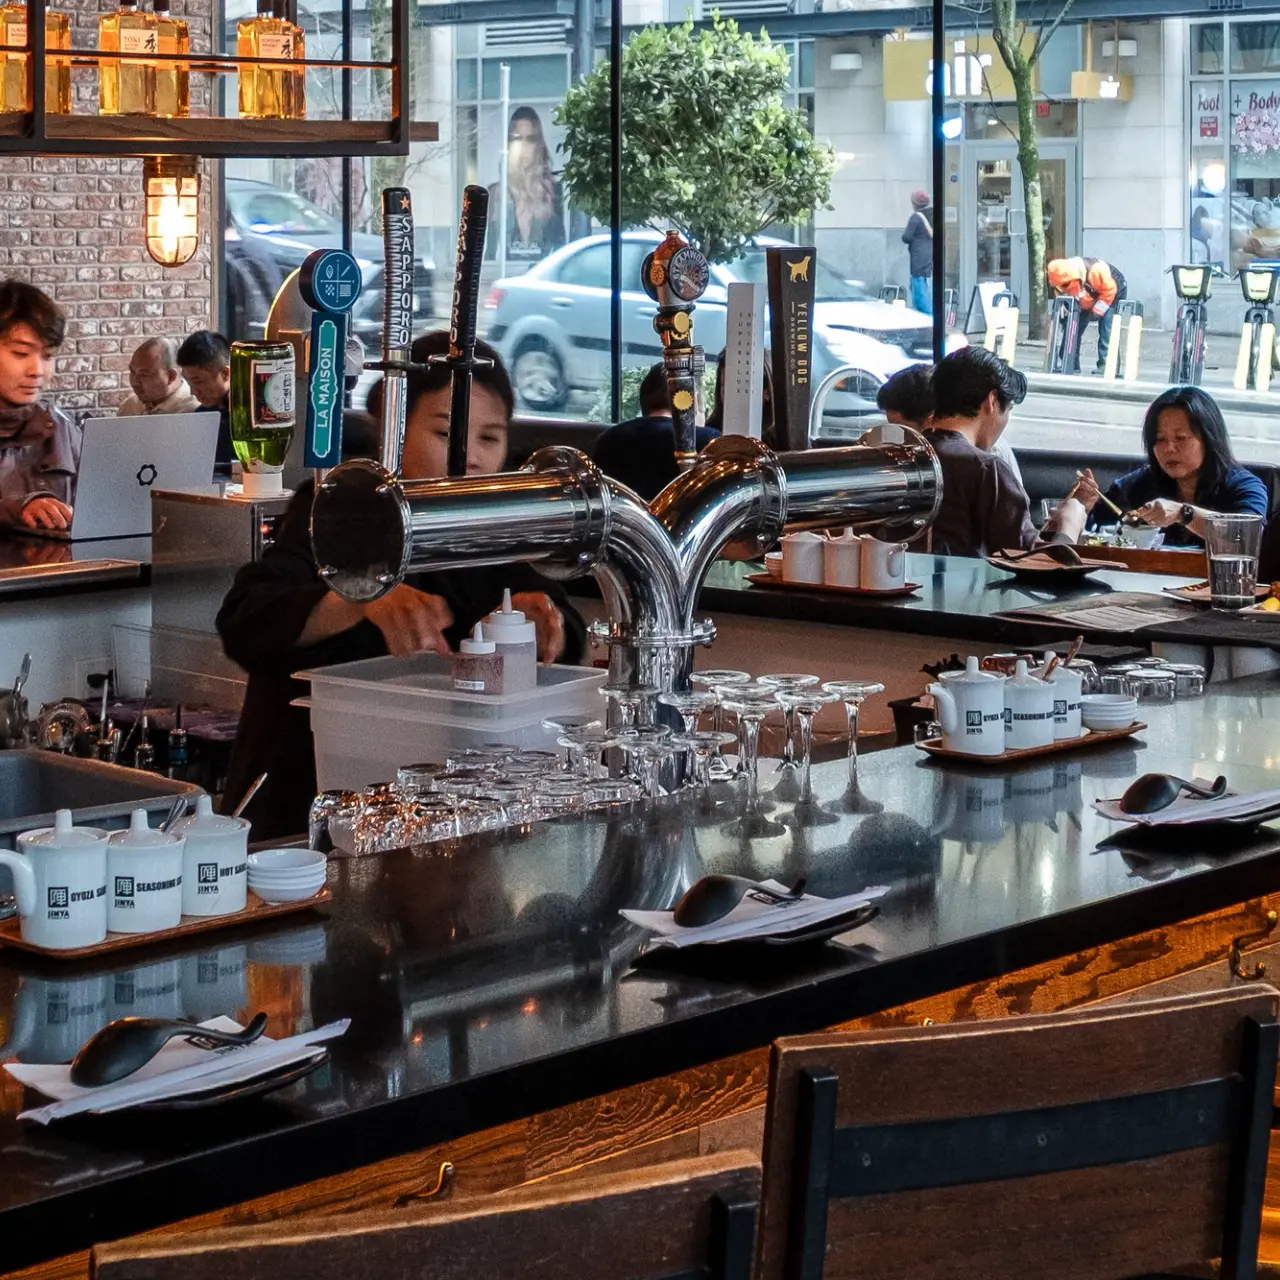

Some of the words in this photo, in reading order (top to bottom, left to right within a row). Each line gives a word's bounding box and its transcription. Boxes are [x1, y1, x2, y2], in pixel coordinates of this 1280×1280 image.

[1249, 90, 1280, 110] Body
[399, 216, 413, 345] SAPPORO
[449, 216, 468, 343] SAPPORO
[797, 302, 808, 353] YELLOW
[319, 347, 332, 405] MAISON
[797, 359, 808, 384] DOG
[317, 407, 329, 428] LA
[220, 867, 233, 877] HOT
[136, 878, 176, 892] SEASONING
[198, 885, 219, 894] JINYA
[70, 890, 95, 903] GYOZA
[114, 899, 135, 908] JINYA
[48, 910, 70, 919] JINYA
